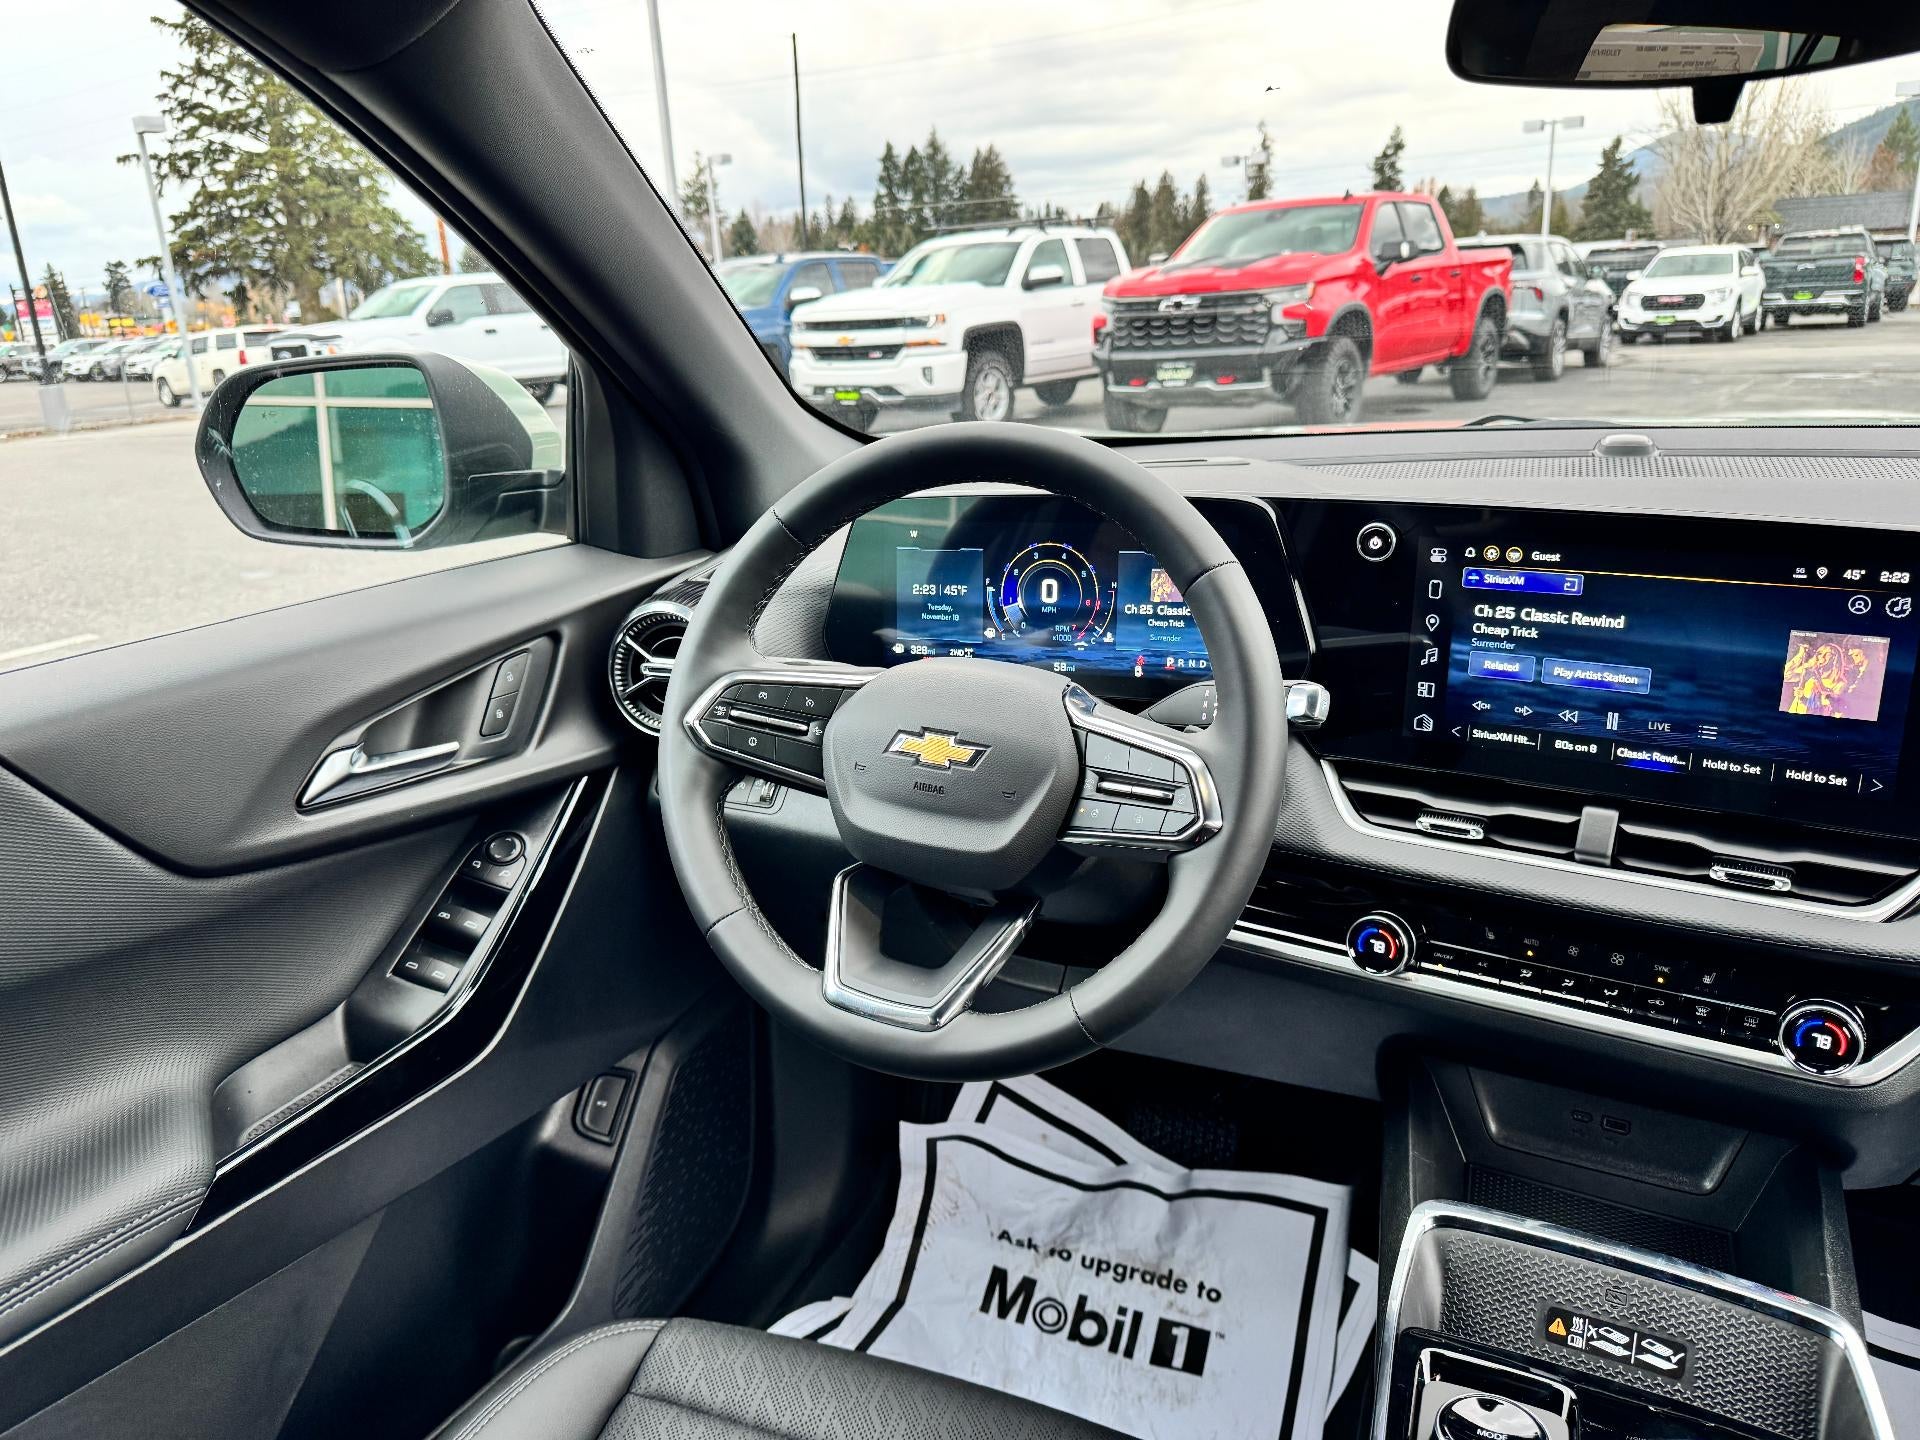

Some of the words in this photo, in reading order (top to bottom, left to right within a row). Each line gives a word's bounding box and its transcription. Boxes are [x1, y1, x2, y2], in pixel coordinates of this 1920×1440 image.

[1588, 48, 1621, 57] HEVROLET
[909, 530, 918, 538] W
[1033, 552, 1039, 560] 3
[1061, 552, 1067, 560] 4
[1531, 551, 1561, 562] Guest
[1483, 573, 1525, 586] SiriusXM
[1880, 571, 1910, 584] 2:23
[912, 584, 936, 595] 2:23
[943, 584, 968, 596] 45°F
[1041, 579, 1058, 604] 0
[927, 603, 953, 612] Tuesday,
[1041, 606, 1057, 614] MPH
[1124, 604, 1137, 614] Ch
[1139, 605, 1153, 615] 25
[1157, 605, 1191, 616] Classic
[921, 613, 952, 621] November
[1474, 604, 1493, 618] Ch
[1495, 605, 1516, 620] 25
[1520, 608, 1569, 625] Classic
[1571, 611, 1625, 629] Rewind
[1055, 625, 1070, 633] RPM
[1148, 619, 1168, 628] Cheap
[1169, 619, 1185, 628] Trick
[1473, 623, 1509, 639] Cheap
[1511, 626, 1539, 639] Trick
[1150, 634, 1182, 642] Surrender
[1471, 638, 1516, 650] Surrender
[949, 648, 965, 657] 2WD
[1166, 657, 1175, 667] P
[1177, 659, 1184, 667] R
[1199, 660, 1207, 668] D
[1483, 660, 1520, 673] Related
[1553, 667, 1574, 680] Play
[1574, 669, 1602, 681] Artist
[1602, 671, 1639, 684] Station
[1480, 702, 1491, 710] CH
[1648, 721, 1672, 732] LIVE
[1472, 729, 1512, 743] SiriusXM
[1554, 739, 1573, 751] 80s
[1575, 744, 1589, 753] on
[1616, 748, 1651, 761] Classic
[1703, 759, 1728, 771] Hold
[1729, 762, 1741, 772] to
[1743, 764, 1762, 775] Set
[1785, 769, 1812, 782] Hold
[1814, 773, 1826, 783] to
[1828, 775, 1848, 786] Set
[913, 781, 945, 794] AIRBAG
[1523, 938, 1540, 946] AUTO
[1811, 1033, 1832, 1050] 78
[997, 1229, 1040, 1254] Ask
[1080, 1254, 1188, 1295] upgrade
[1196, 1280, 1223, 1303] to
[979, 1264, 1144, 1360] Mobil
